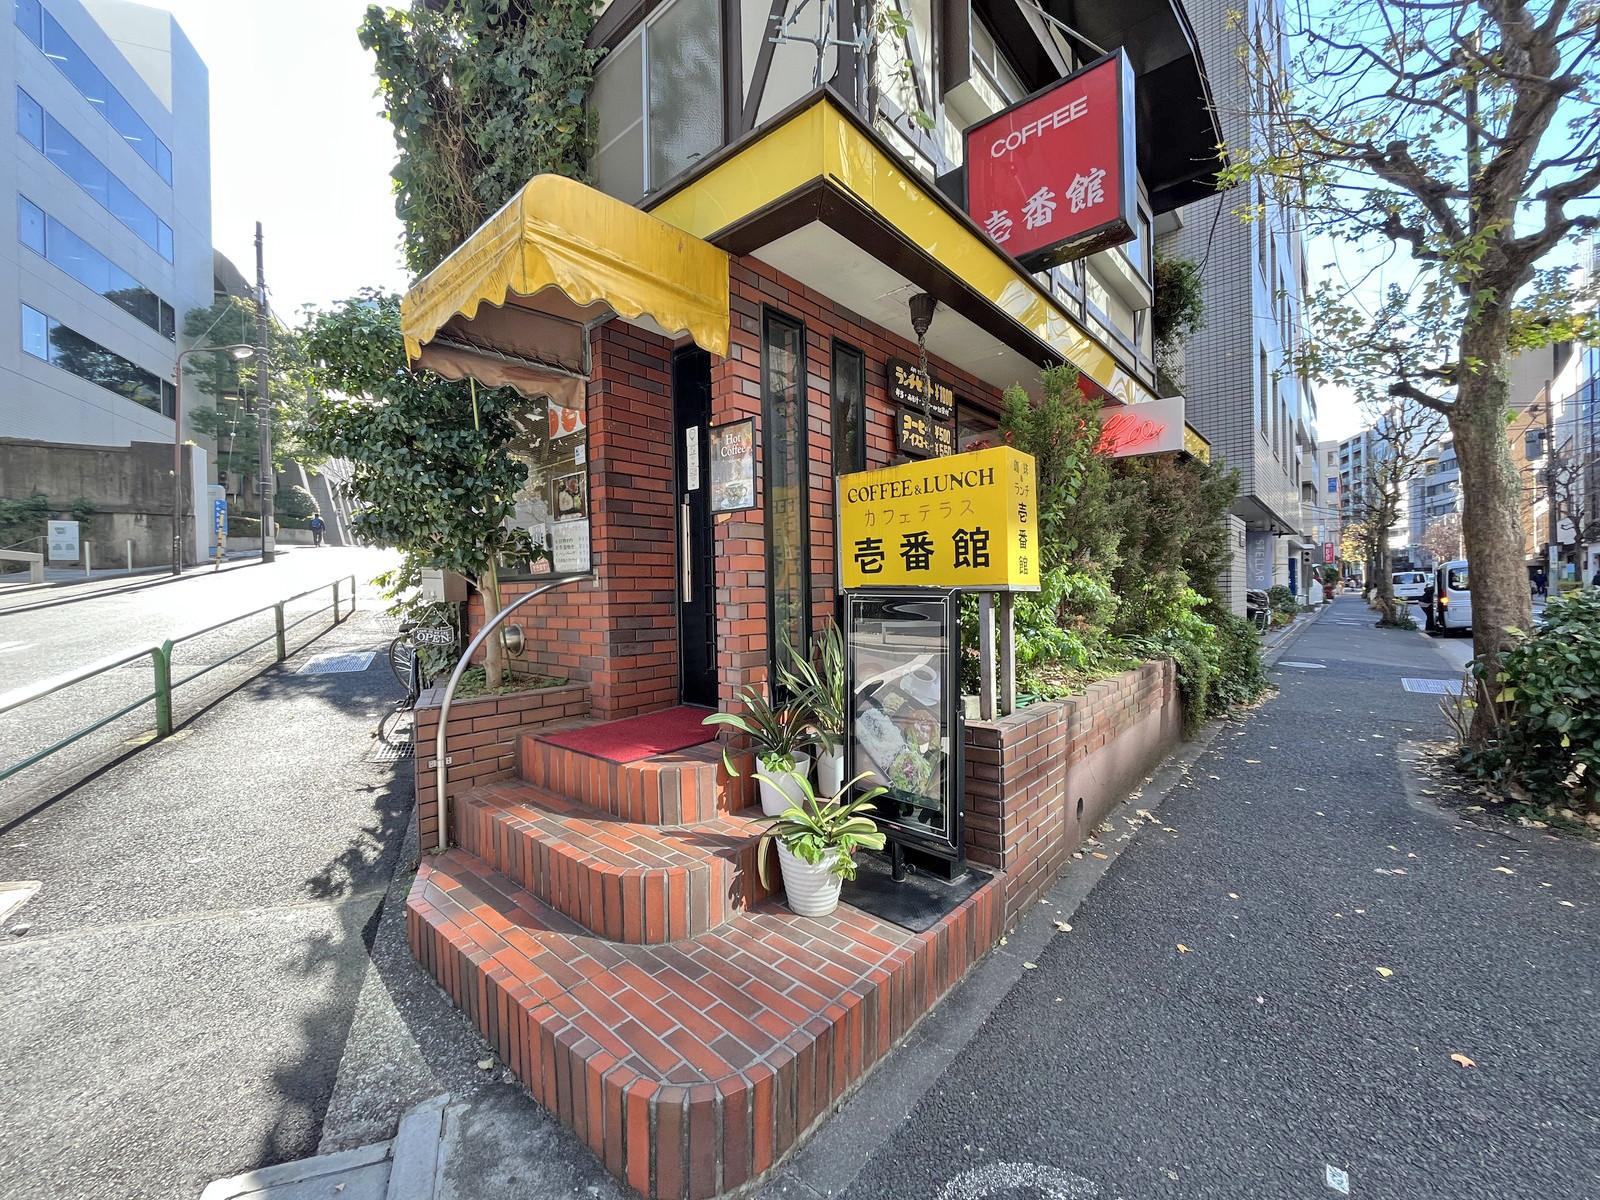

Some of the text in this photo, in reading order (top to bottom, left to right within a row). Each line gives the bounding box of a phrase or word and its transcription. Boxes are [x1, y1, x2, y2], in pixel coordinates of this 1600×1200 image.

[991, 95, 1088, 158] COFFEE
[984, 168, 1107, 244] 壱番館
[721, 444, 747, 458] Coffee
[725, 434, 742, 445] Hot
[1014, 482, 1030, 497] ランチ
[865, 499, 975, 527] カフェテラス
[854, 526, 990, 575] 壱番館
[1018, 502, 1029, 575] 壱番館
[416, 632, 450, 643] OPEN
